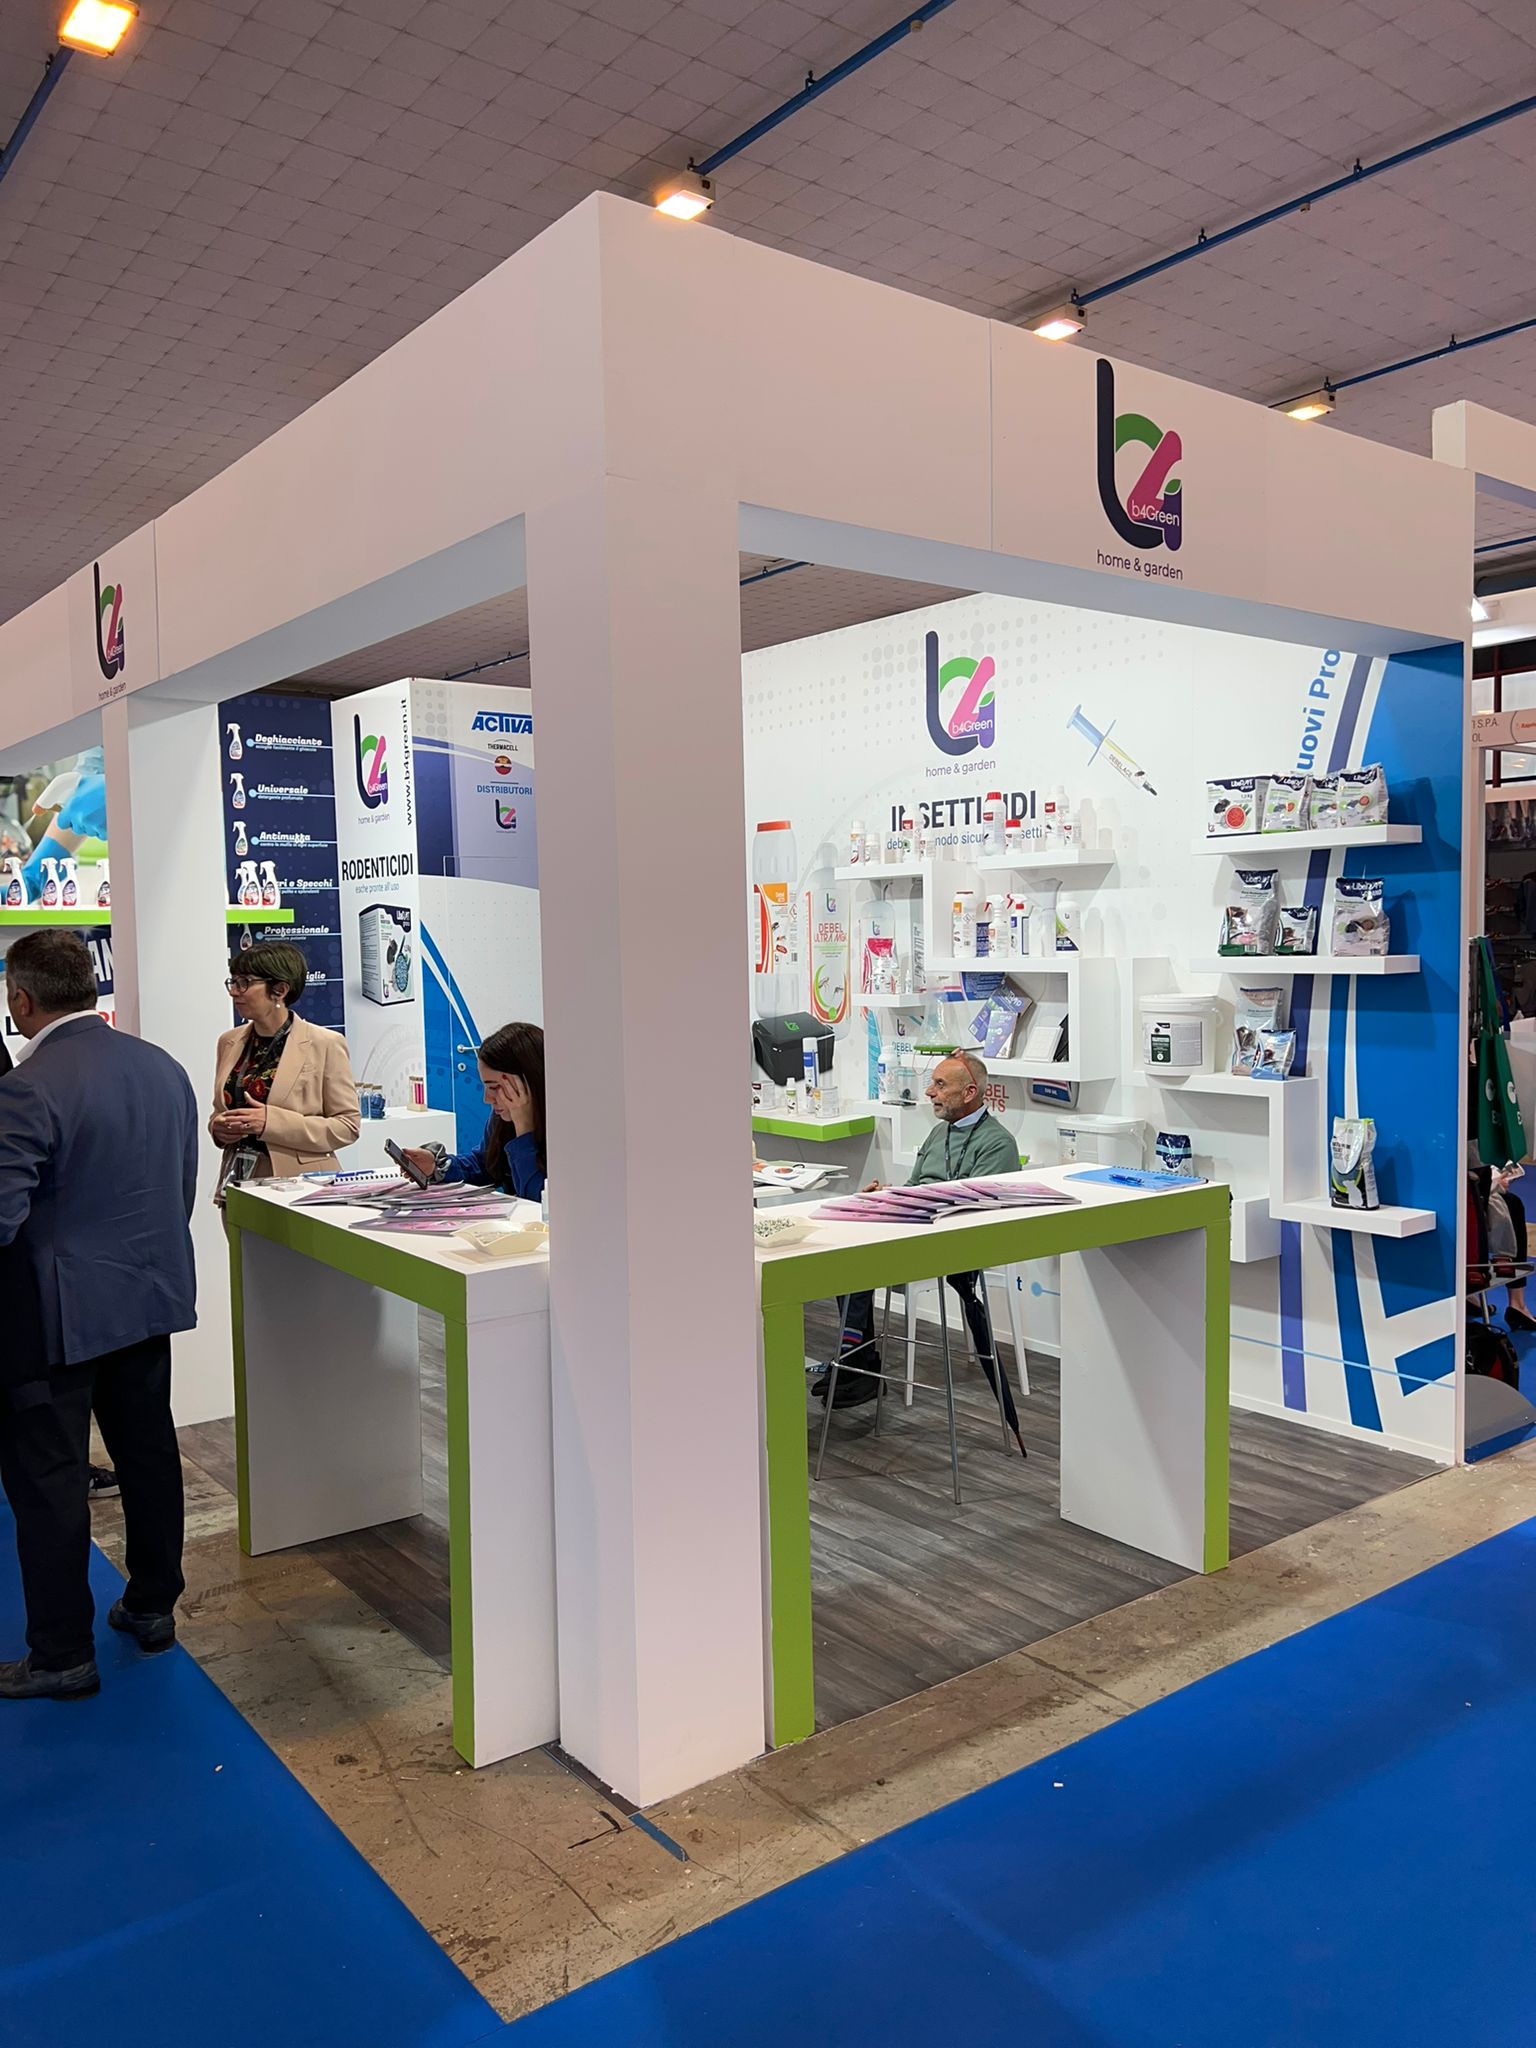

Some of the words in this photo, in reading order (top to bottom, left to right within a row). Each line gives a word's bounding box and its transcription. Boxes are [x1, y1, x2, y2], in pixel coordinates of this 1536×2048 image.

[1131, 500, 1180, 526] b4Green
[1097, 549, 1131, 570] home
[1133, 558, 1141, 572] &
[1144, 561, 1183, 580] garden
[1308, 649, 1341, 699] Pro
[471, 711, 533, 734] ACTIVA
[951, 718, 993, 735] b4Green
[255, 733, 323, 746] Deghiacciante
[1296, 707, 1325, 771] uovi
[400, 697, 412, 826] www.b4green.it
[925, 766, 952, 778] home
[953, 763, 960, 773] &
[962, 759, 996, 776] garden
[257, 784, 309, 794] Universale
[476, 785, 533, 795] DISTRIBUTORI
[357, 815, 371, 825] home
[374, 812, 390, 823] garden
[259, 831, 311, 843] Antimuffa
[341, 853, 413, 881] RODENTICIDI
[296, 879, 333, 889] Specchi
[264, 925, 330, 937] Professionale
[818, 923, 844, 934] DEBEL
[984, 1083, 1010, 1099] BEL
